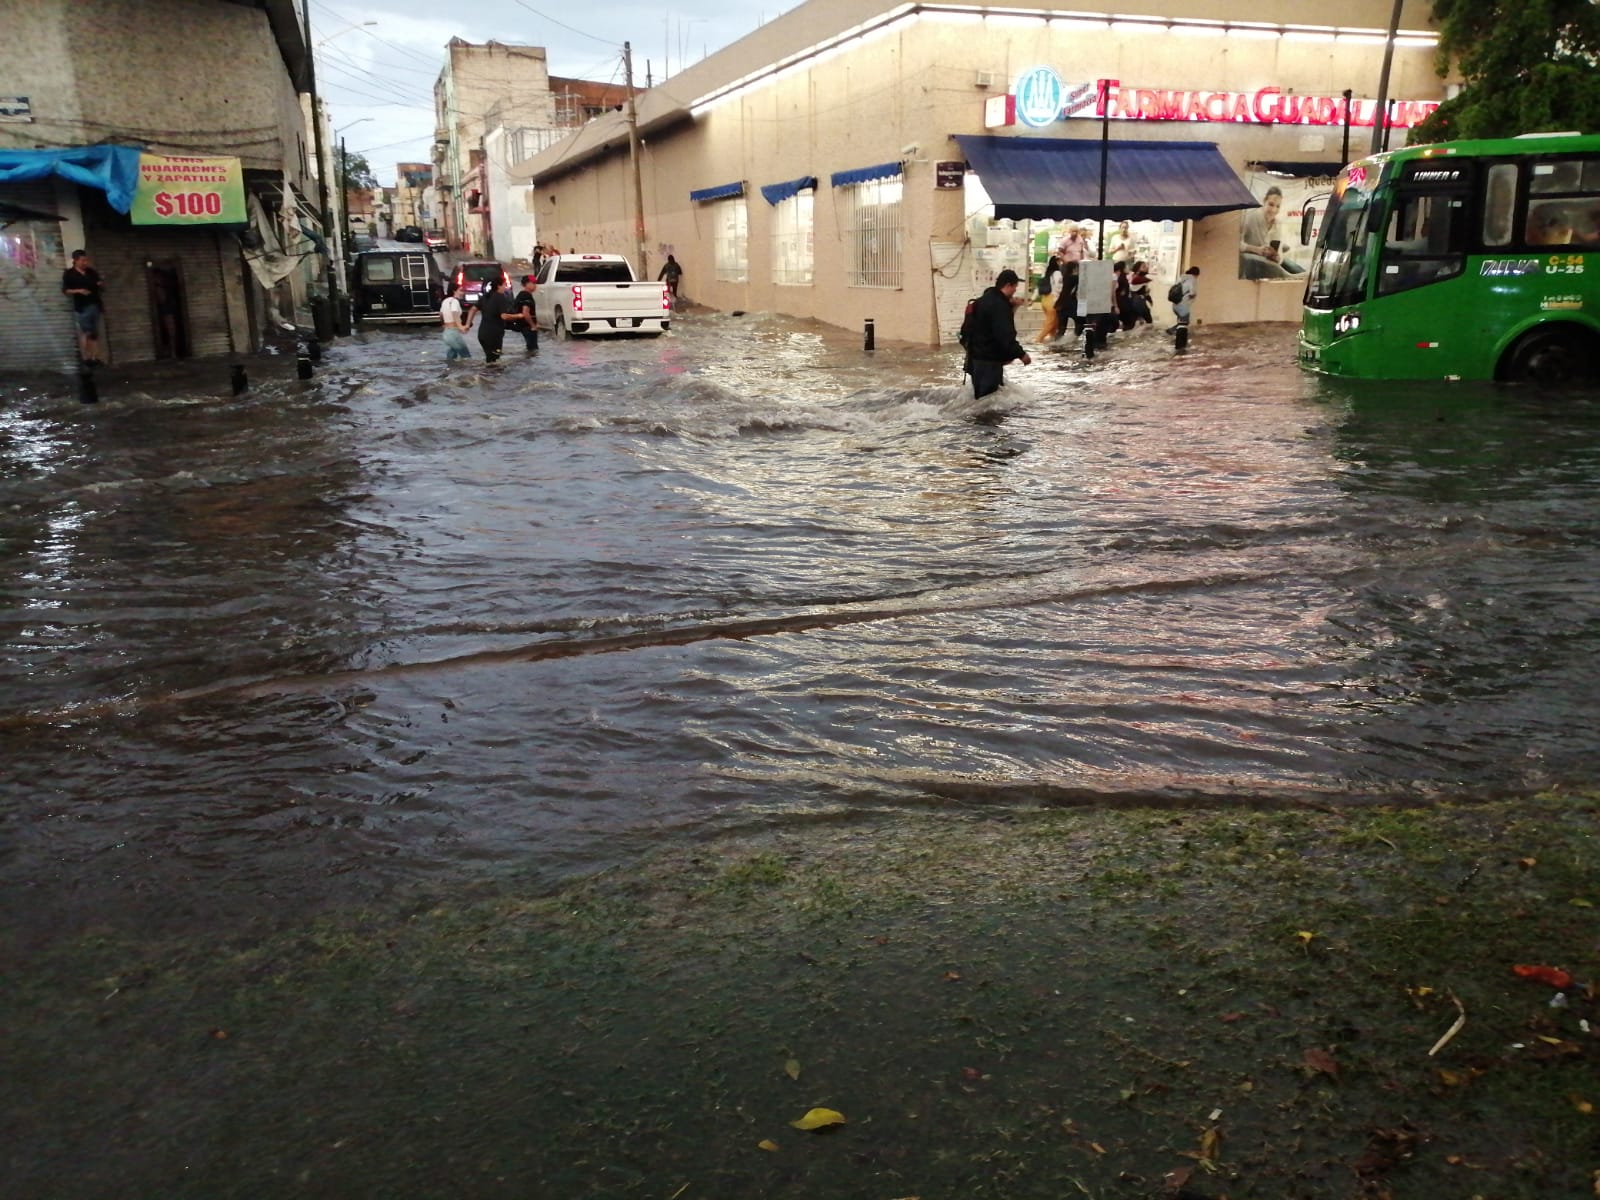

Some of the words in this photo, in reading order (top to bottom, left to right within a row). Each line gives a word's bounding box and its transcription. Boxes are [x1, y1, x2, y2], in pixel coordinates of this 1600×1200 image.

[1097, 79, 1250, 122] FARMACIA
[141, 165, 227, 173] HUARACHES
[143, 174, 152, 182] Y
[155, 191, 221, 216] $100
[1545, 265, 1584, 274] U-25
